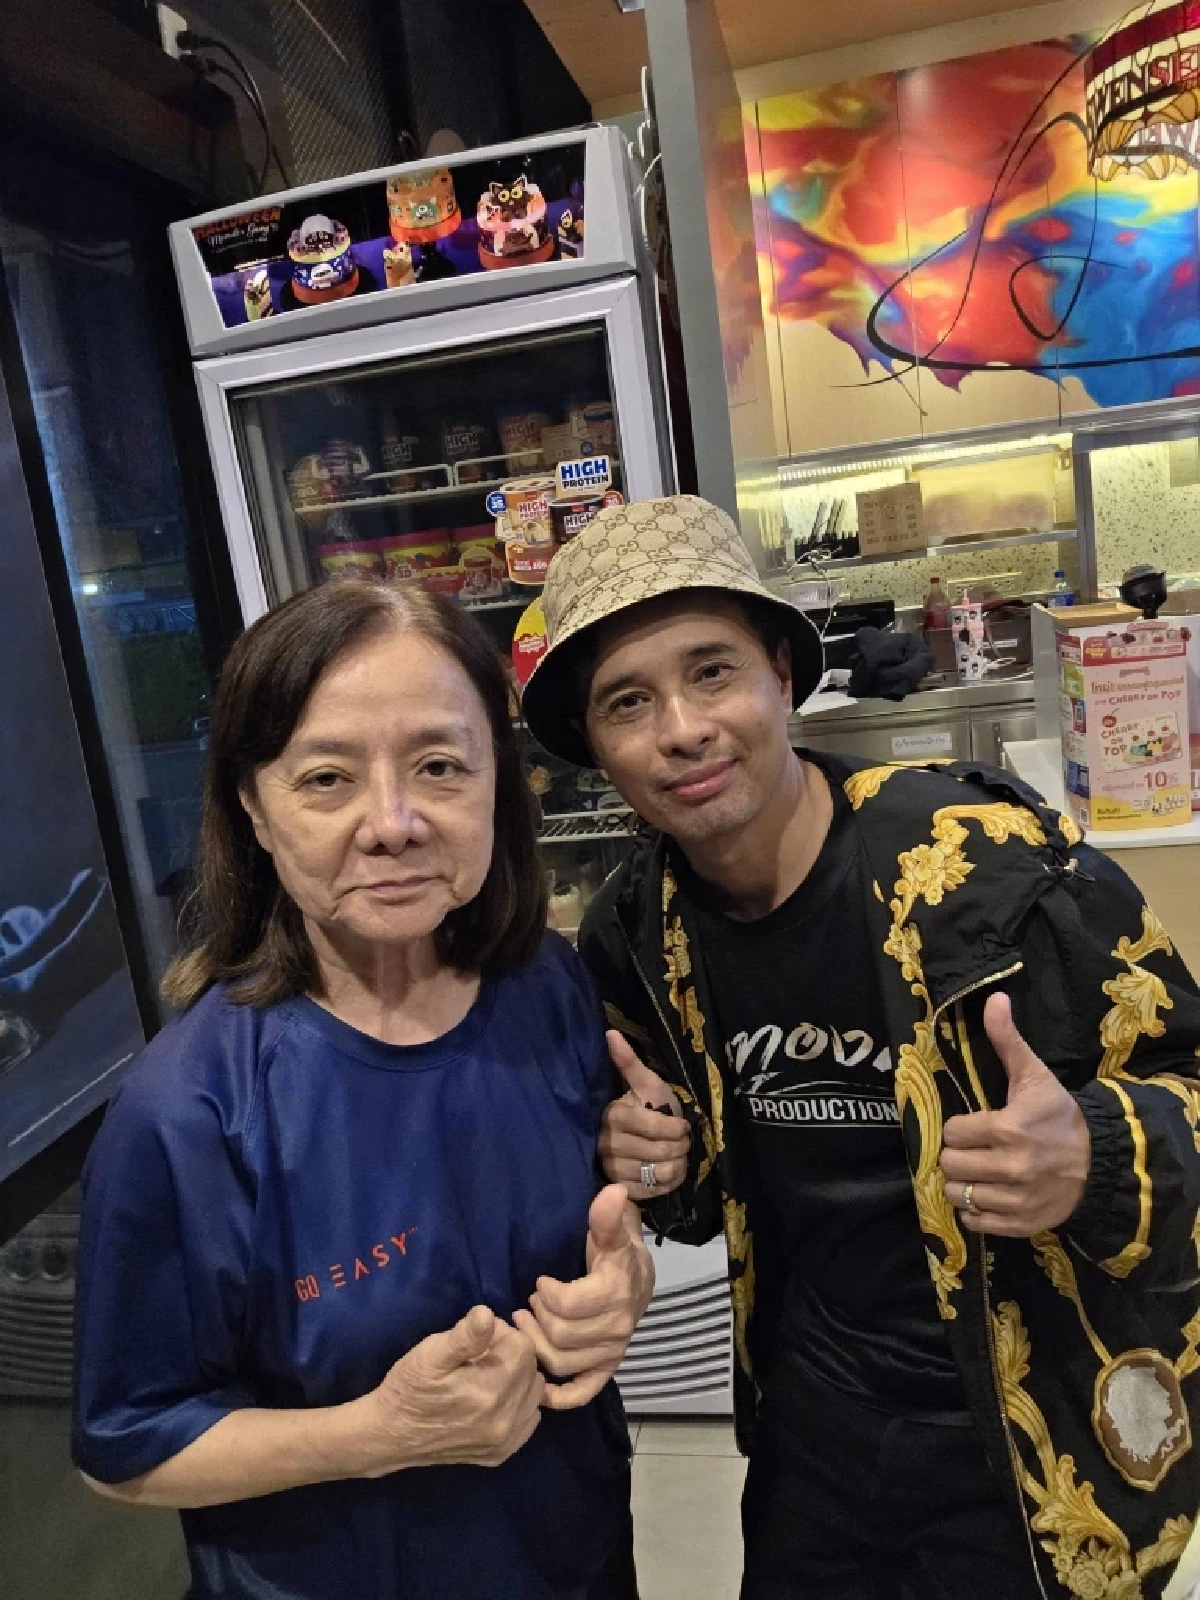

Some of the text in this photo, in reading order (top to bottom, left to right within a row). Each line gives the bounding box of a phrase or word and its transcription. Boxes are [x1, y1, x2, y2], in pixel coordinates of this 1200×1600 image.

[560, 458, 608, 480] HIGH
[562, 474, 609, 490] PROTEIN
[518, 500, 549, 513] HIGH
[1108, 693, 1146, 706] CHERRY
[1161, 690, 1182, 700] TOP
[1101, 722, 1140, 739] CHERRY
[1103, 745, 1128, 756] TOP
[749, 1097, 901, 1122] PRODUCTION
[294, 1274, 320, 1302] GO
